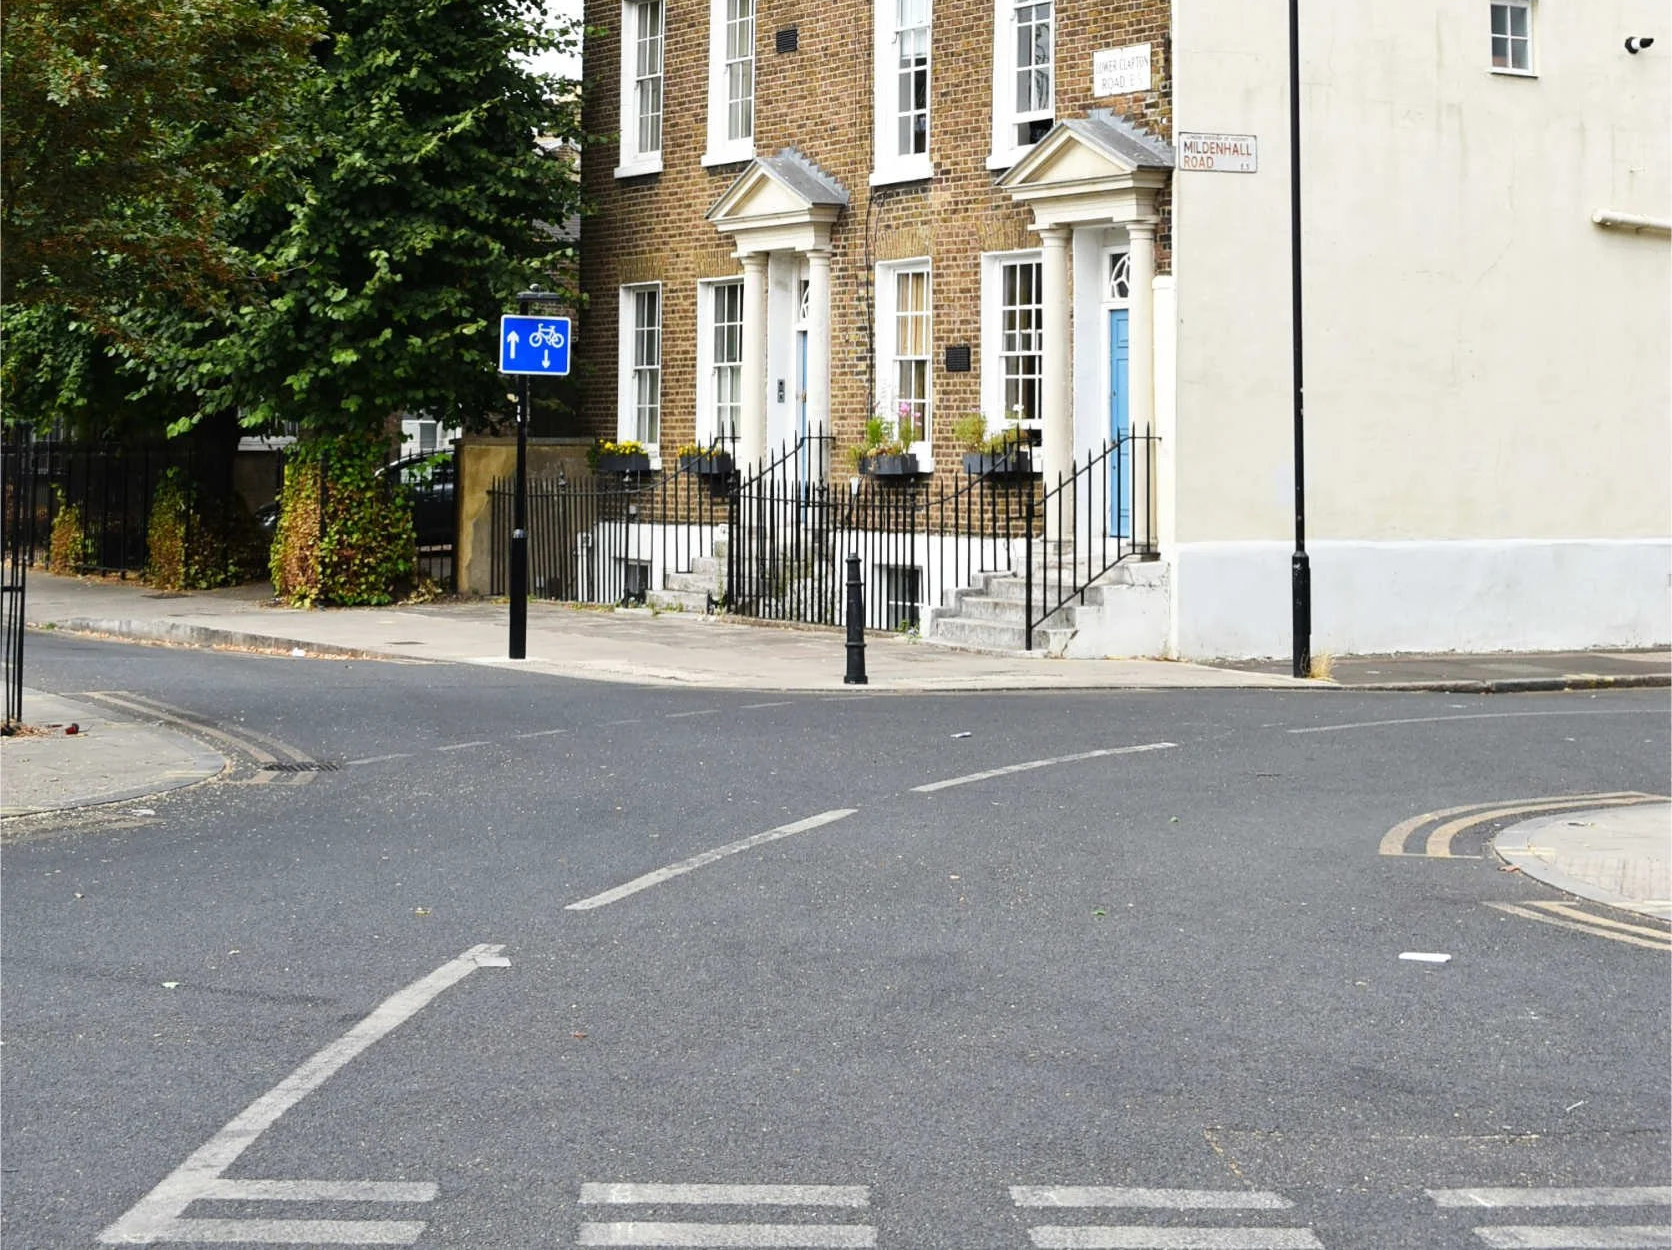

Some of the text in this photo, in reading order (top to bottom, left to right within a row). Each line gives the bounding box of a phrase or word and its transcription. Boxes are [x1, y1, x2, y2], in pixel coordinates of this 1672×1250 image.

[1096, 55, 1148, 74] LOWER CLAPTON
[1184, 141, 1252, 156] MILDENHALL
[1184, 155, 1214, 168] ROAD
